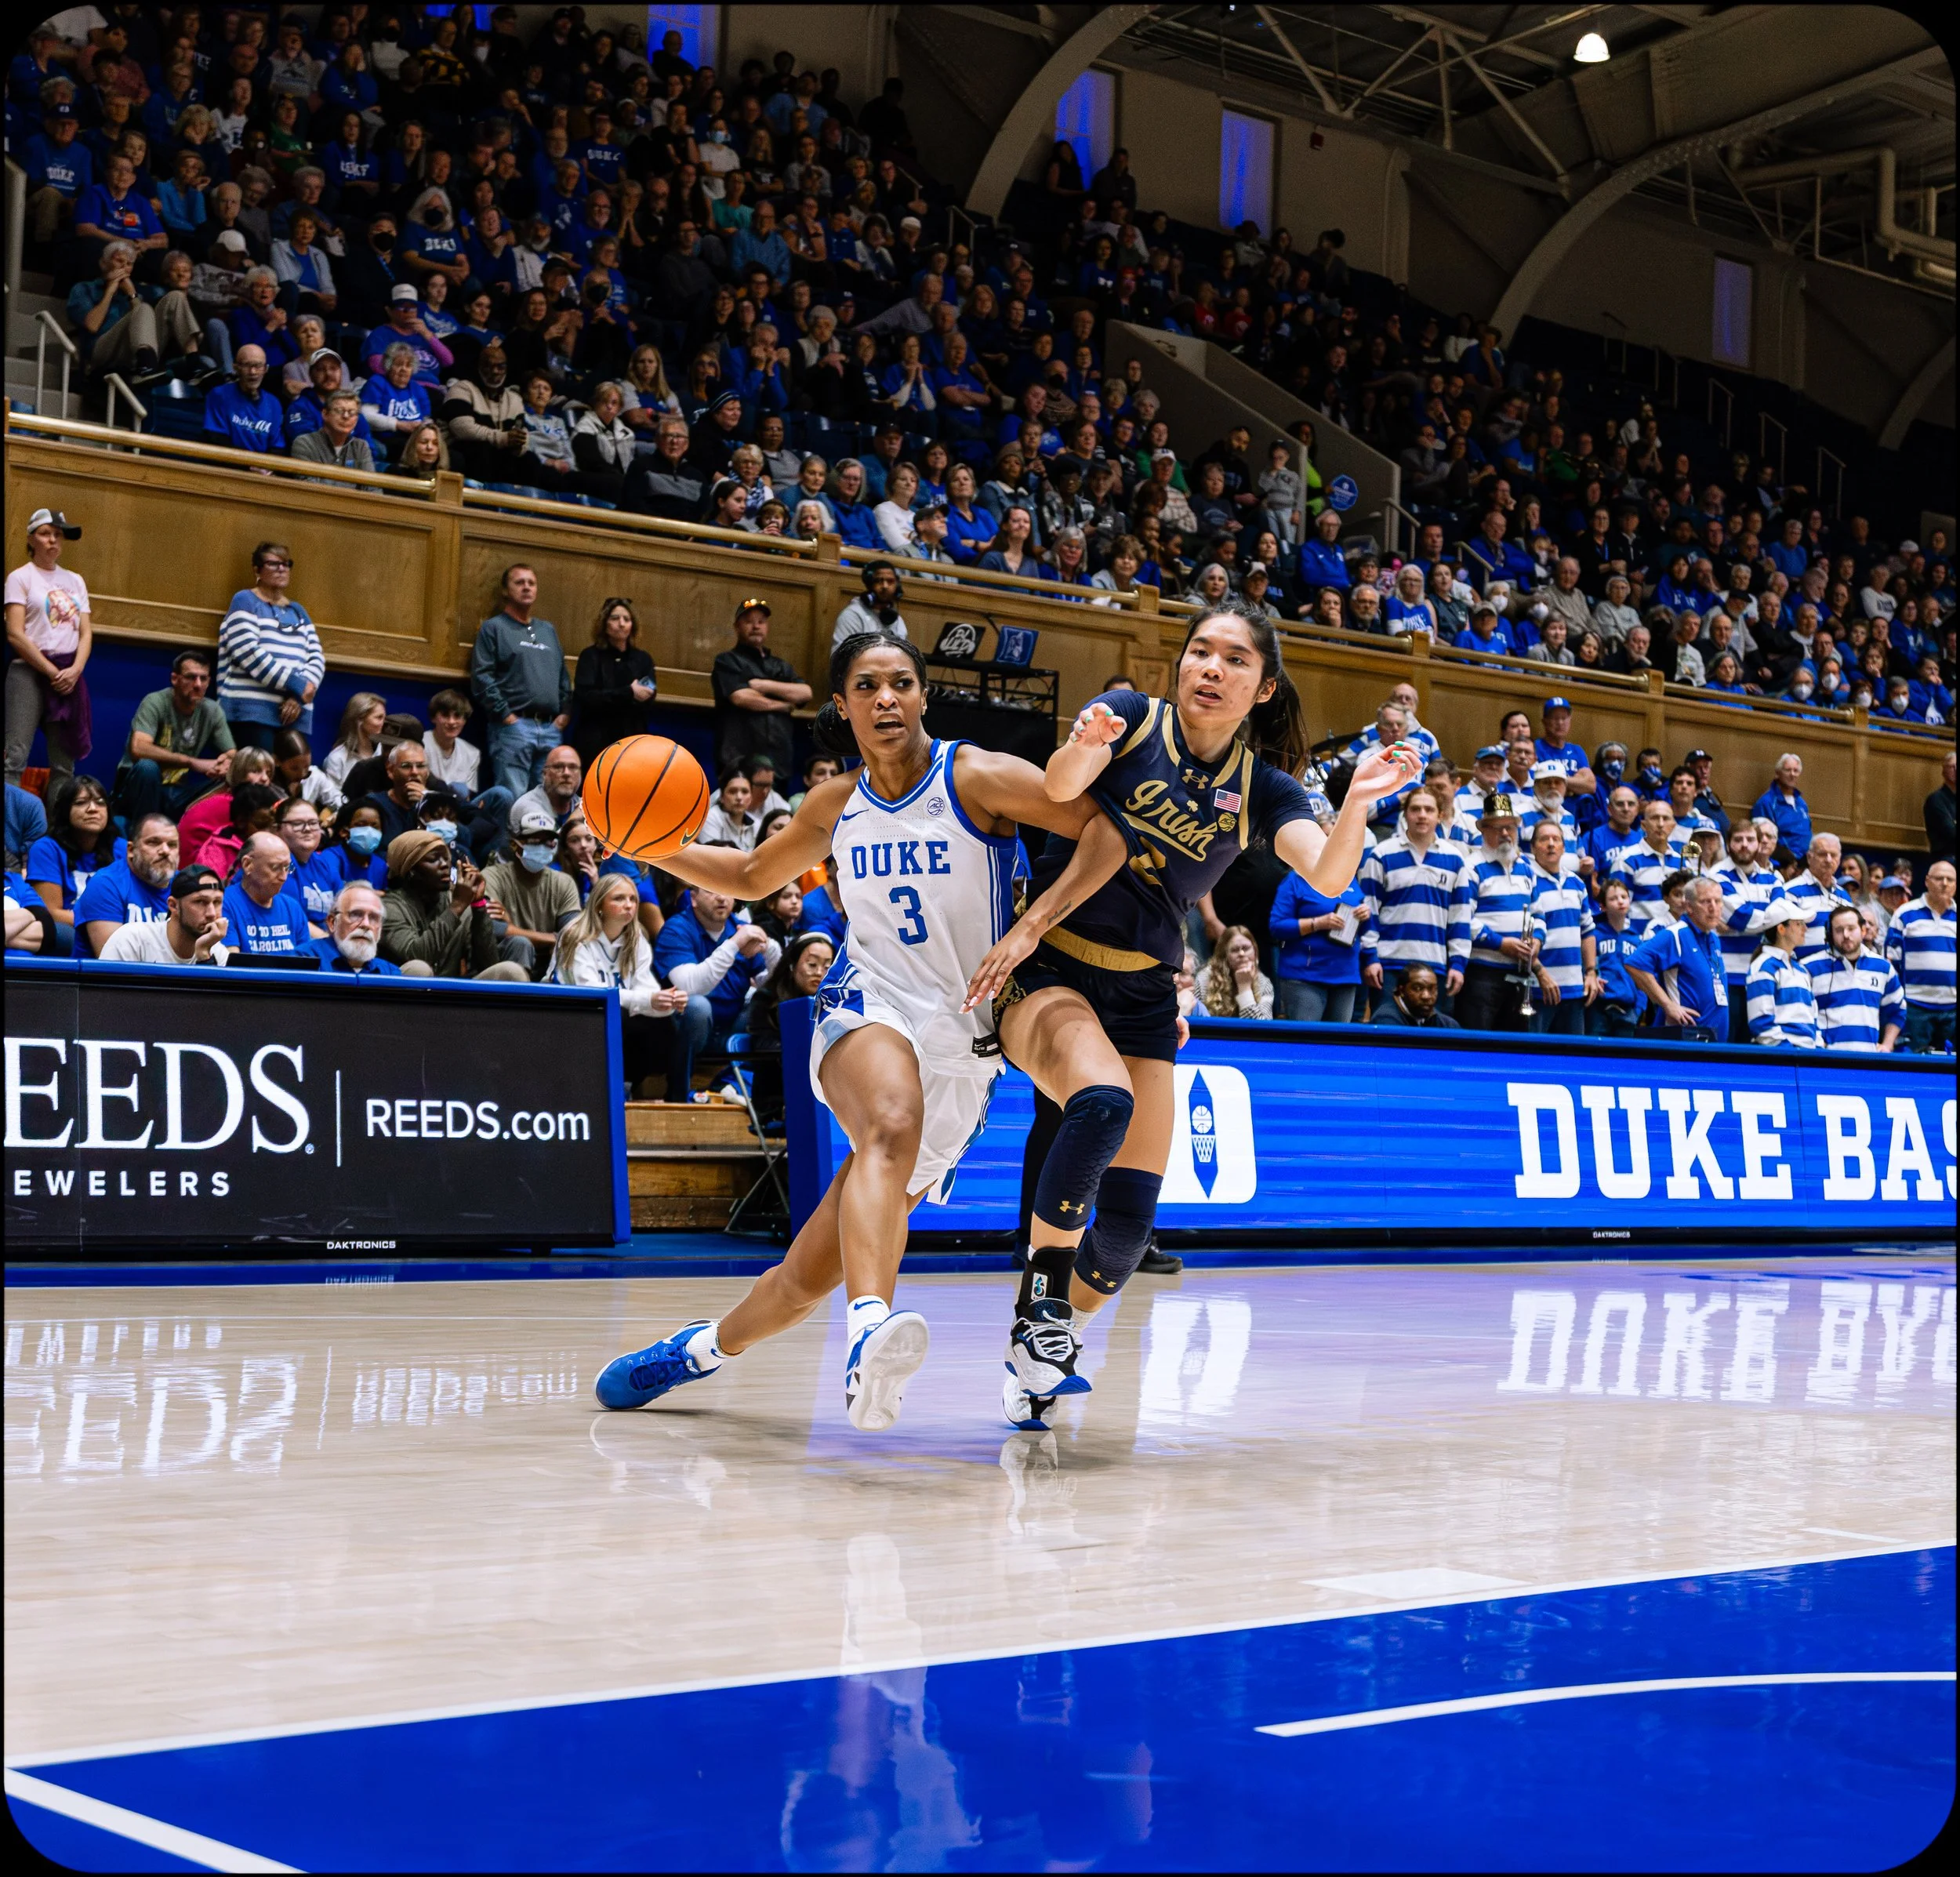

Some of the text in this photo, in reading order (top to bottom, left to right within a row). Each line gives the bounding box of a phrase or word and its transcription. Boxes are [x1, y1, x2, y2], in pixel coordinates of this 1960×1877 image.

[1125, 780, 1218, 861] Irish
[851, 840, 951, 879] DUKE
[888, 885, 928, 946] 3
[366, 1098, 590, 1141] REEDS.com
[1507, 1082, 1957, 1201] DUKE BA
[14, 1169, 230, 1196] EWELERS
[326, 1240, 396, 1249] DAKTRONICS
